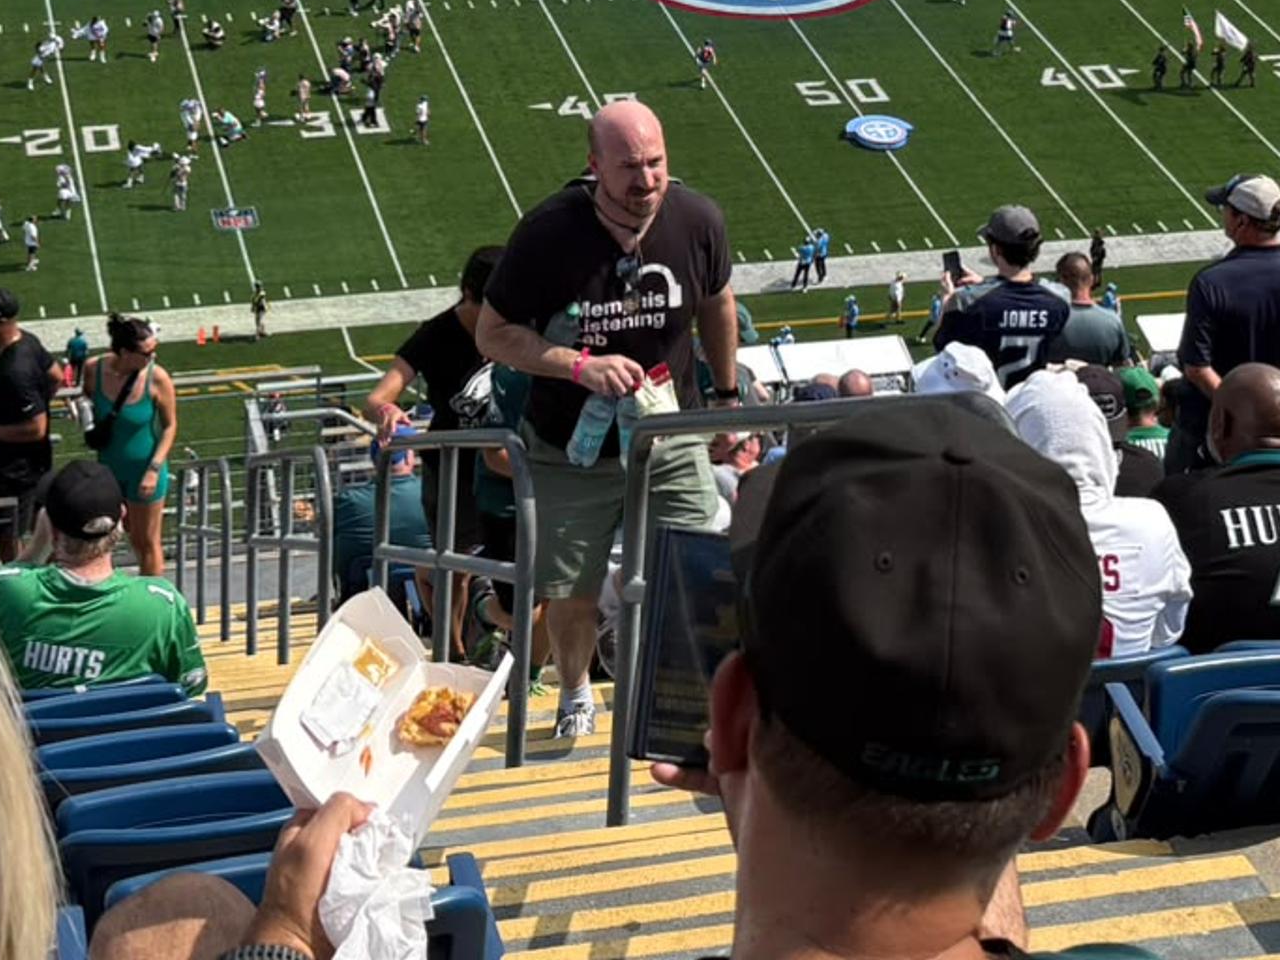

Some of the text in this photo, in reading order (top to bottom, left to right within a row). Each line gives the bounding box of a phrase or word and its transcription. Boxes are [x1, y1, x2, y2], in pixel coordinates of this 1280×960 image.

[1040, 64, 1126, 91] 40
[795, 78, 891, 106] 50
[298, 109, 391, 138] 30
[24, 123, 121, 156] 20
[579, 290, 665, 318] emis
[579, 312, 666, 330] istening
[999, 309, 1049, 328] JONES
[578, 334, 608, 347] ab
[24, 640, 104, 680] HURTS
